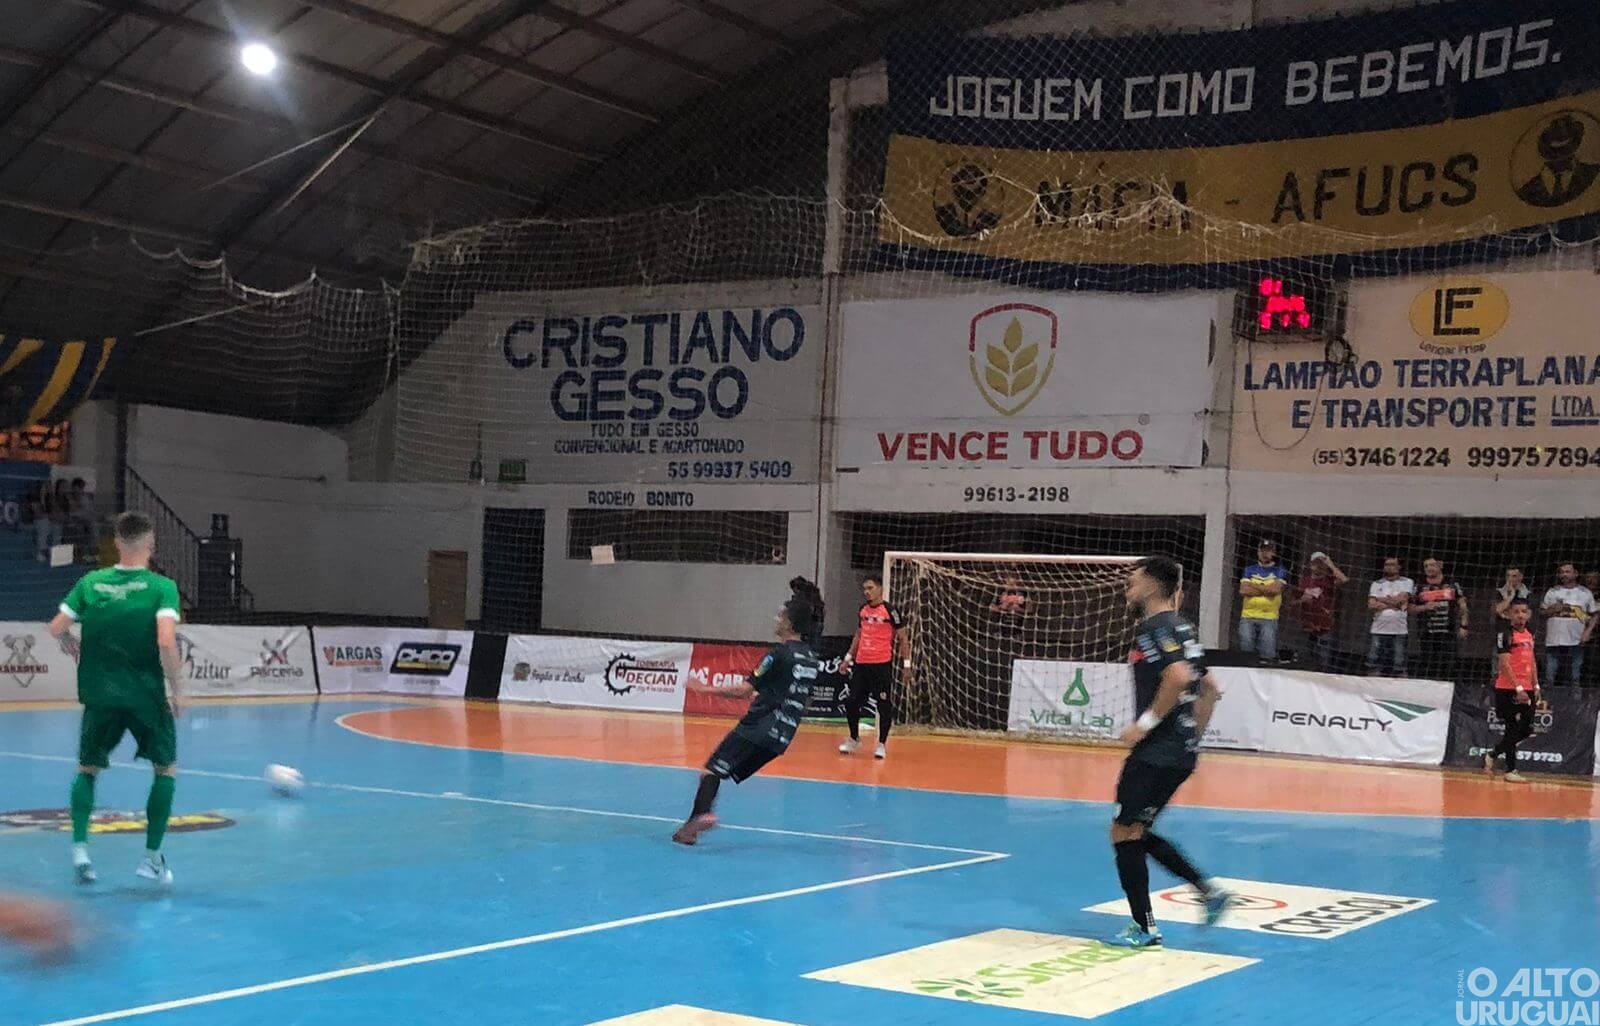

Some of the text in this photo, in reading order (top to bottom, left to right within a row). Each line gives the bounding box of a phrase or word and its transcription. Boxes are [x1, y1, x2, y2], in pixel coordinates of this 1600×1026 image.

[929, 18, 1564, 122] JOGUEM COMO BEBEMOS.
[1271, 151, 1479, 224] AFUCS
[502, 307, 806, 368] CRISTIANO
[549, 366, 750, 421] GESSO
[1291, 400, 1312, 429] E
[1322, 396, 1537, 428] TRANSPORTE
[590, 422, 700, 438] TUDO EM GESSO
[553, 438, 745, 454] CONVENCIONAL E ACARTONADO
[877, 430, 1144, 461] VENCE TUDO
[587, 490, 694, 507] RODEIO BONITO
[963, 486, 1070, 503] 99613-2198
[323, 645, 383, 667] VARGAS
[625, 672, 678, 688] DECIAN
[1029, 708, 1115, 728] Vital Lab
[1271, 710, 1392, 732] PENALTY
[1259, 894, 1420, 937] CRESOL
